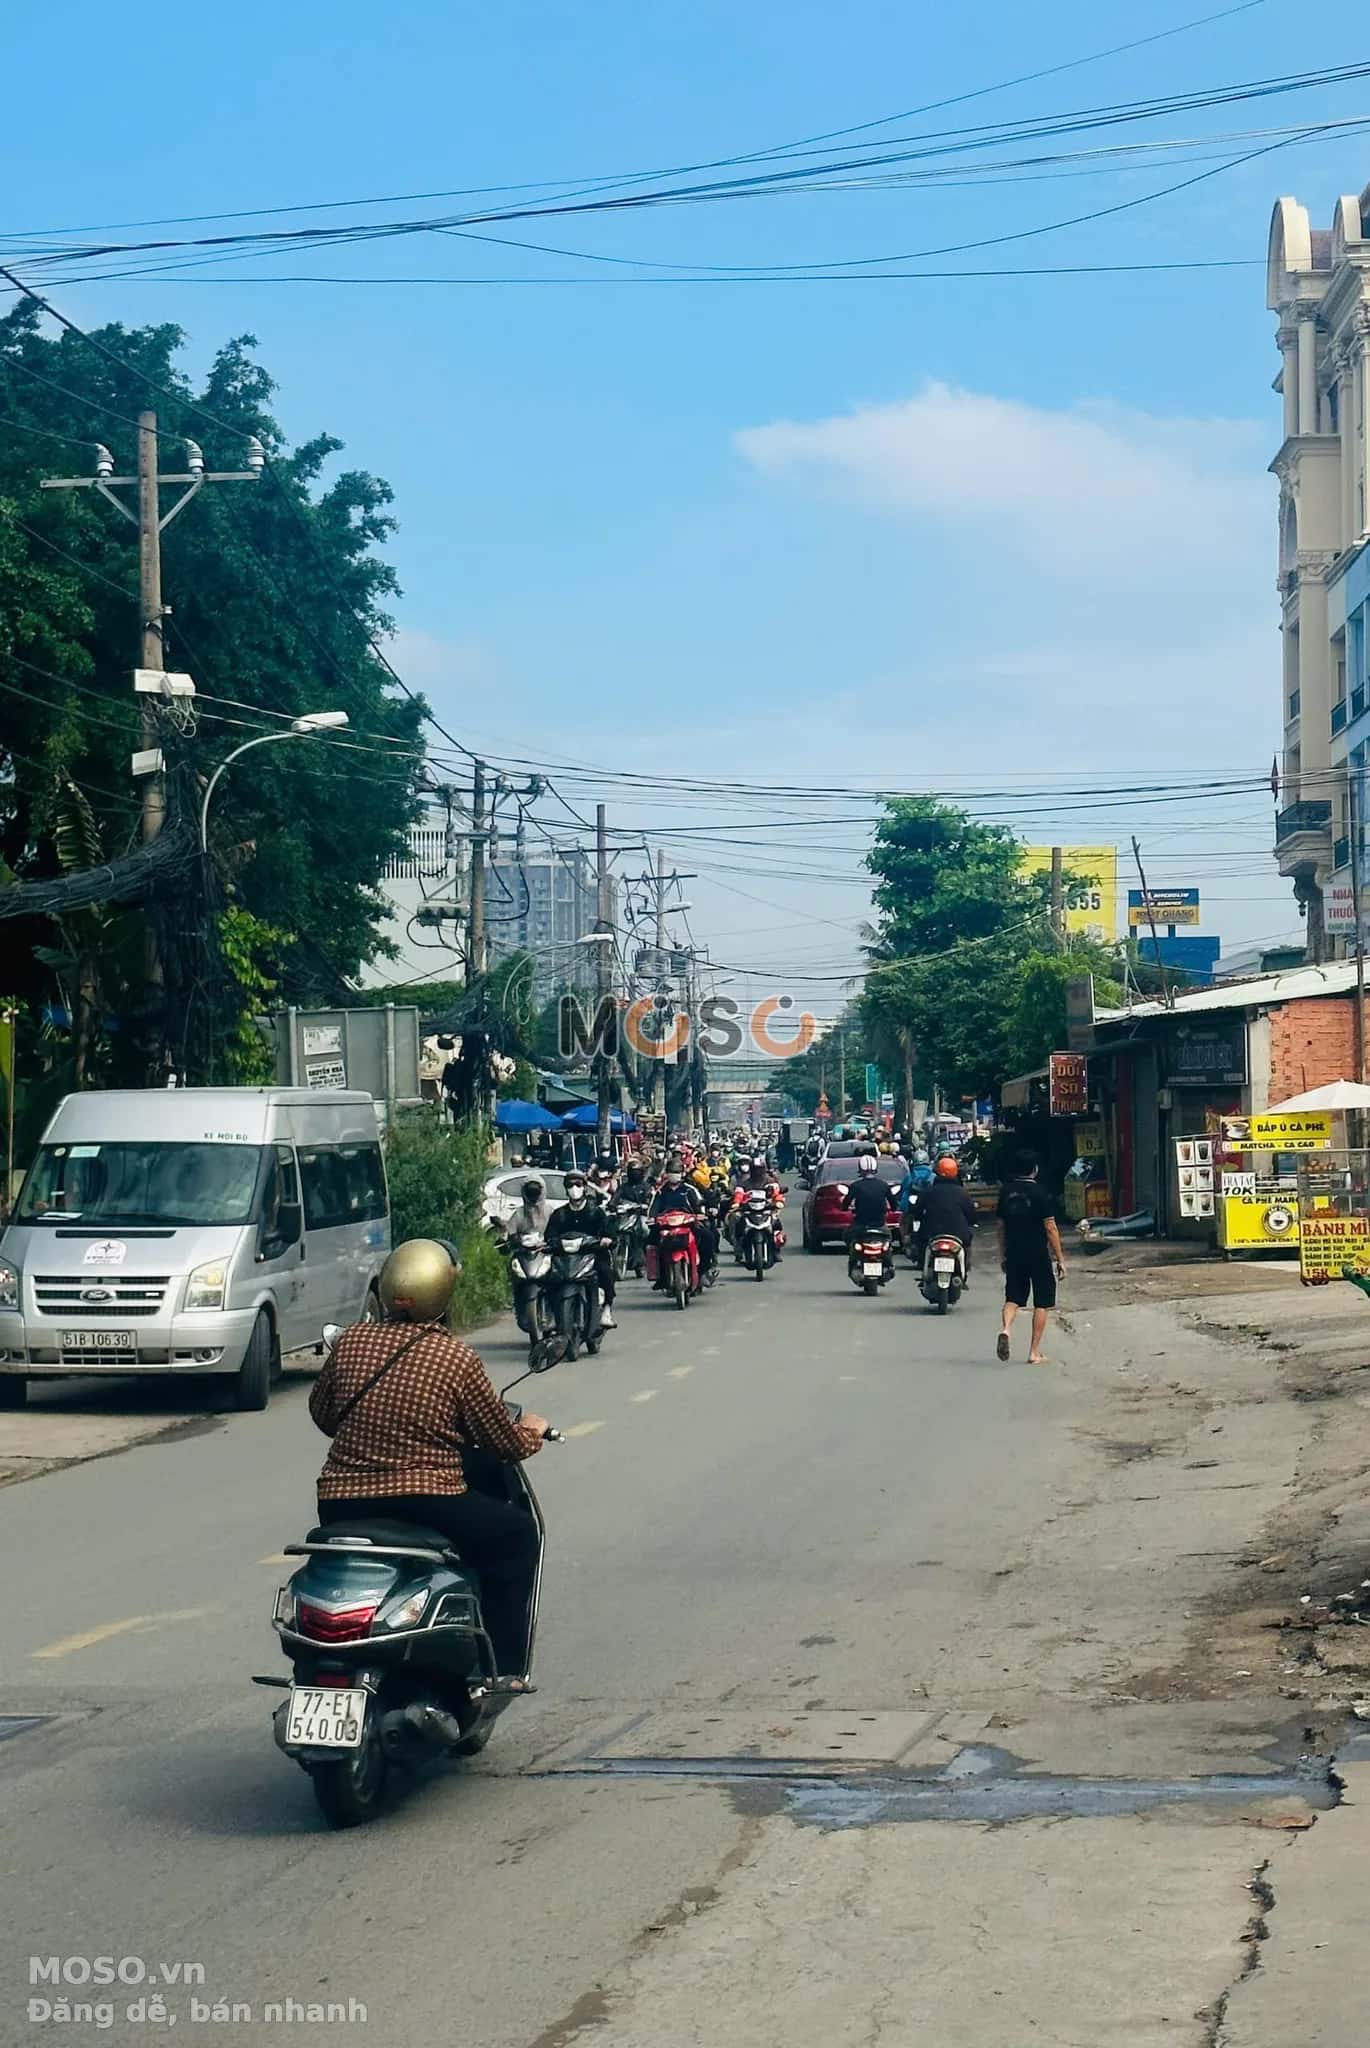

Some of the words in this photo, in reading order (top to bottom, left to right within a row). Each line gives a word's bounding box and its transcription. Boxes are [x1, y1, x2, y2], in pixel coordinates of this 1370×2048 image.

[1223, 1187, 1253, 1196] 10K
[302, 1691, 352, 1719] 77-E1
[291, 1716, 358, 1742] 540.03
